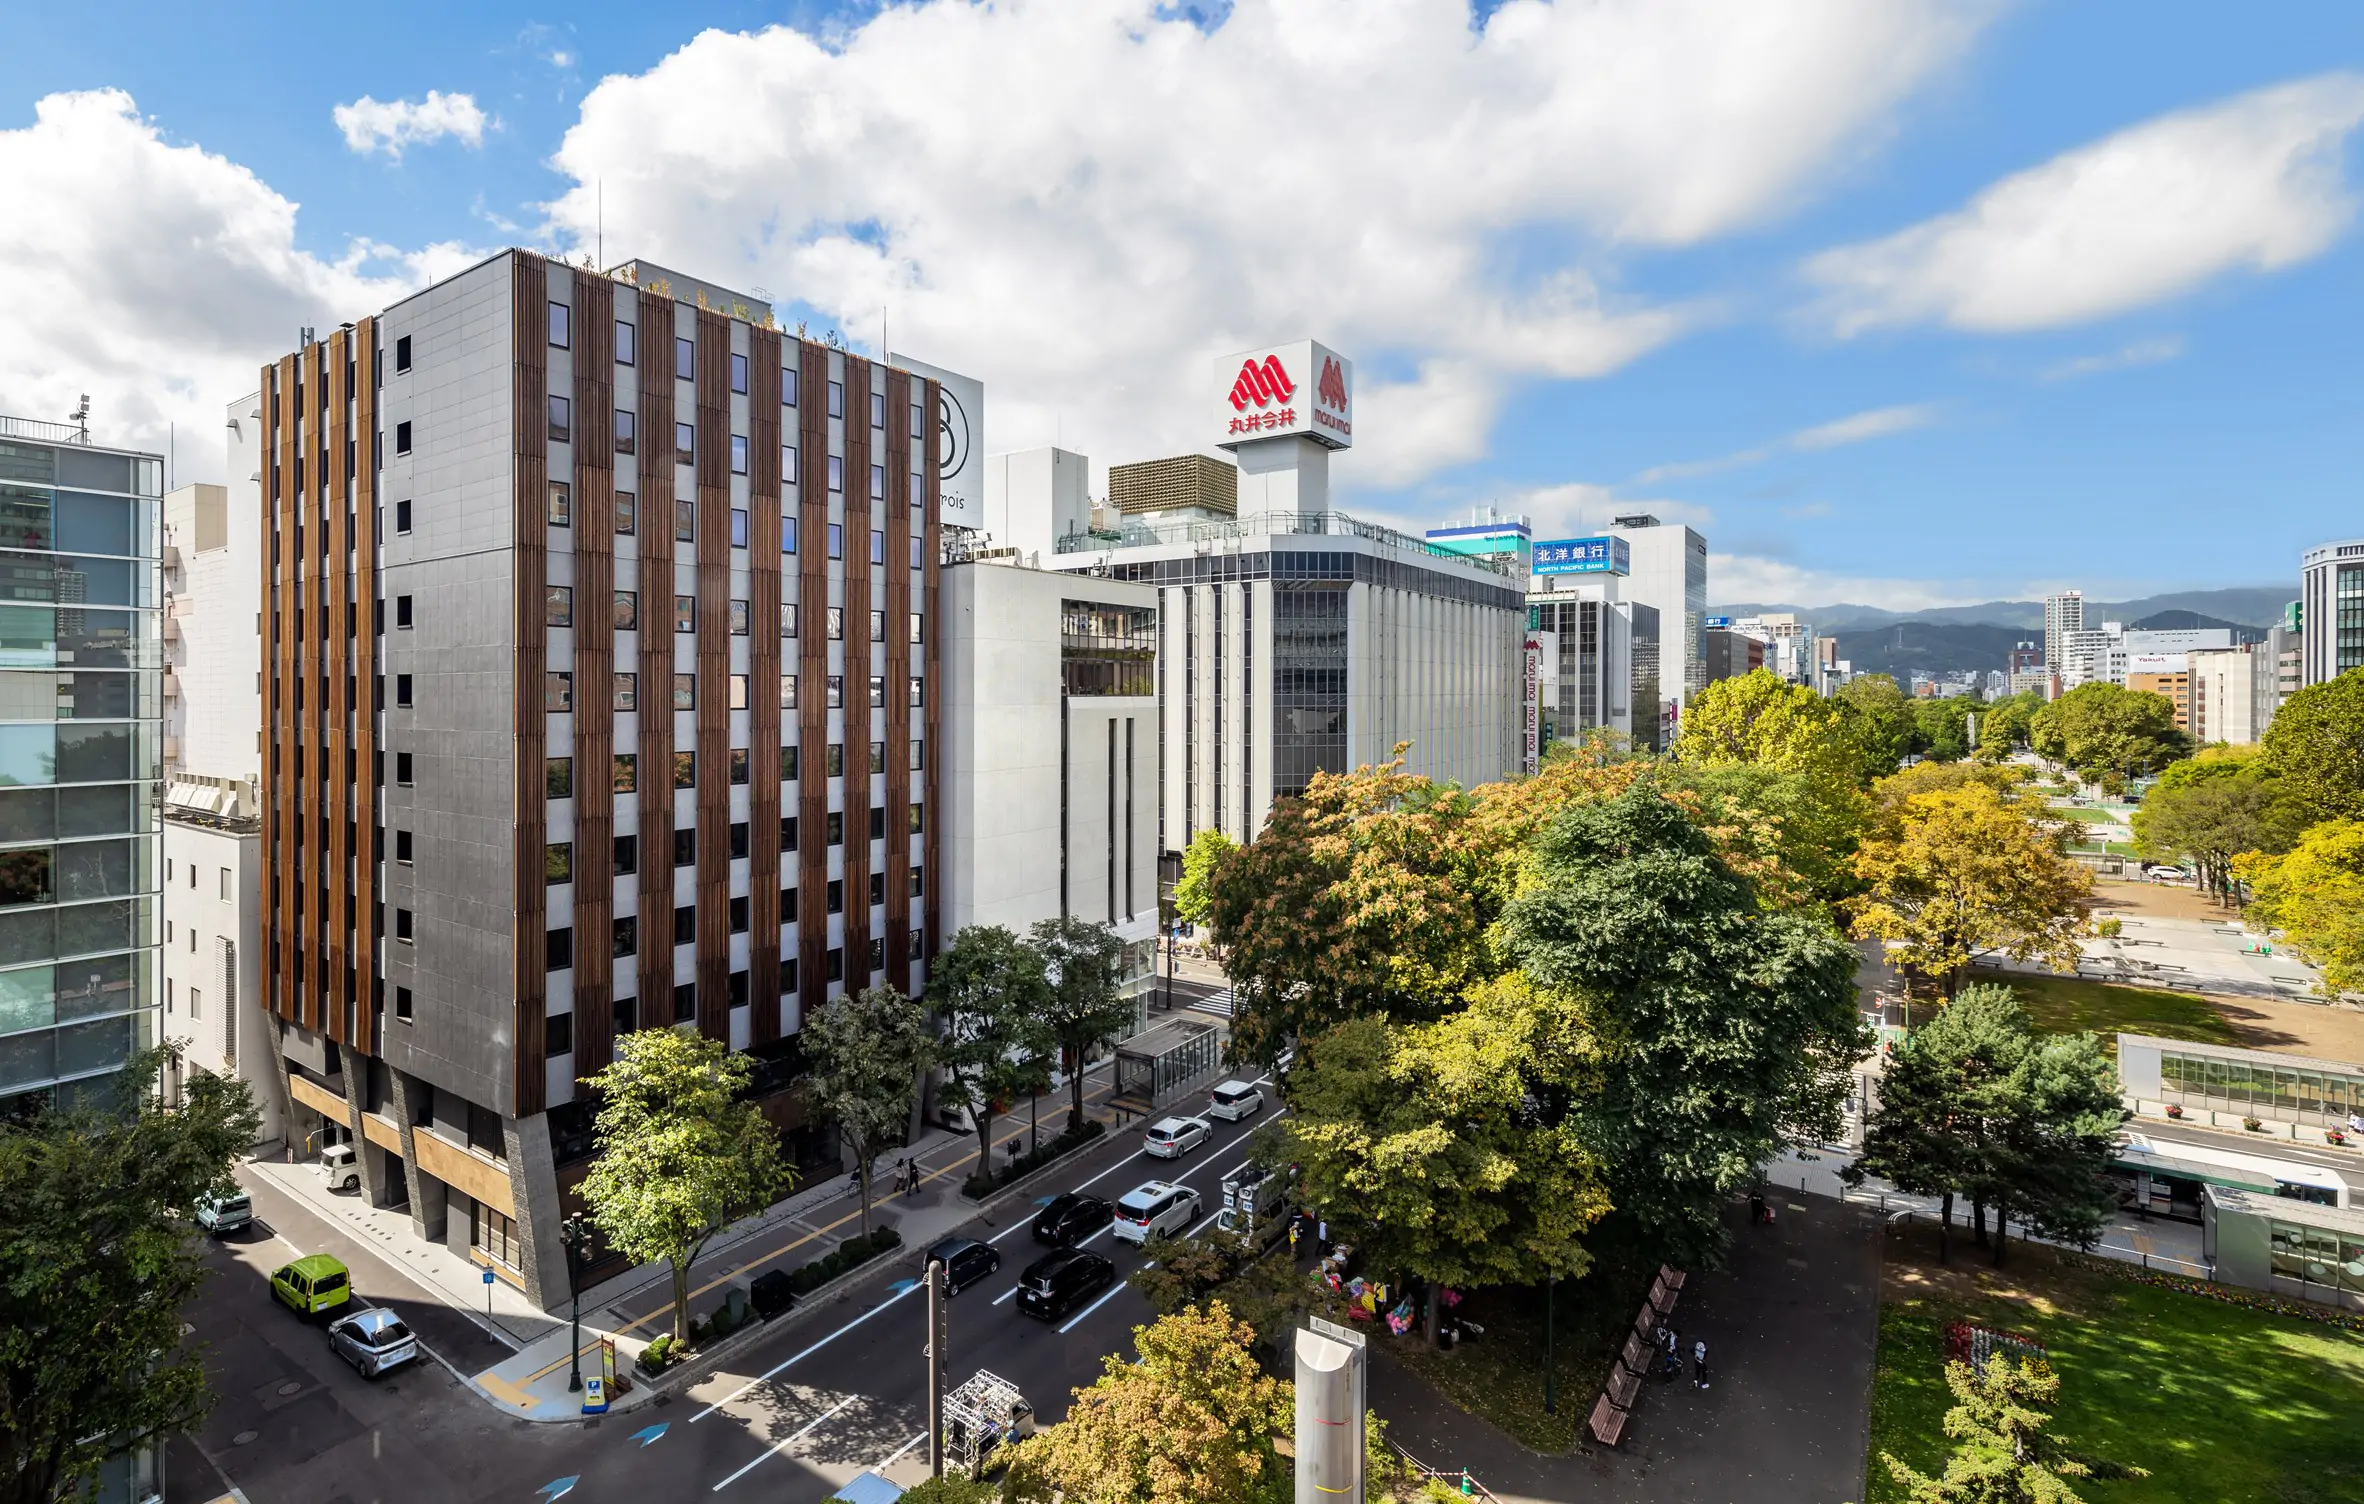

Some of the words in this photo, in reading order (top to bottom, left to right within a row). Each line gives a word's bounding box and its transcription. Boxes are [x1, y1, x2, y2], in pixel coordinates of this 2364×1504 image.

[1228, 408, 1296, 434] 丸井今井
[940, 490, 965, 509] rois
[1538, 545, 1604, 561] 北洋銀行
[1528, 655, 1536, 681] marui
[1528, 706, 1536, 731] marui
